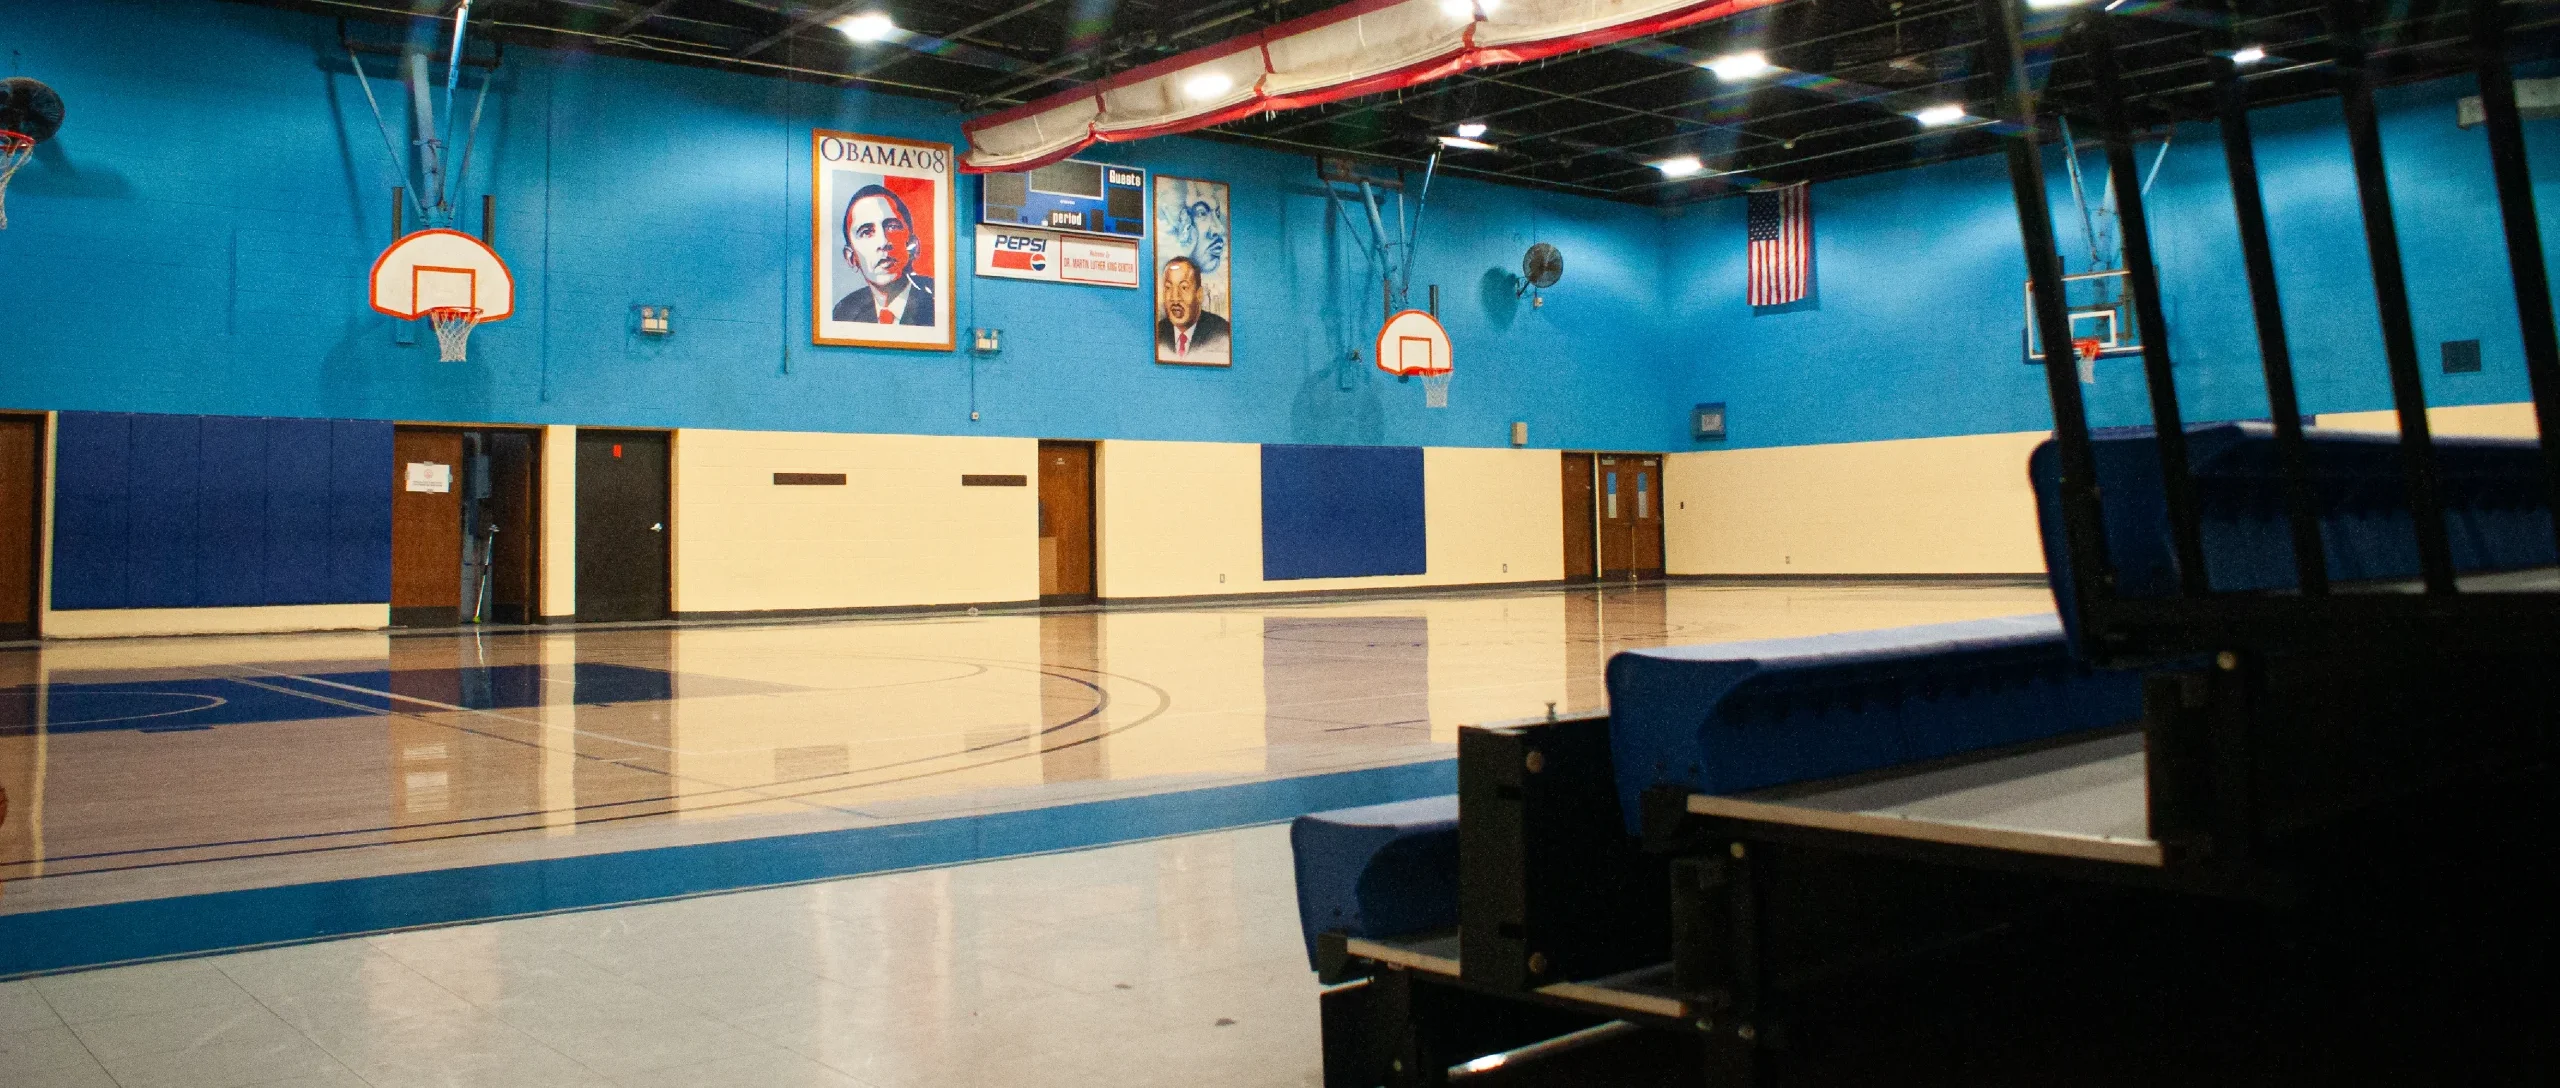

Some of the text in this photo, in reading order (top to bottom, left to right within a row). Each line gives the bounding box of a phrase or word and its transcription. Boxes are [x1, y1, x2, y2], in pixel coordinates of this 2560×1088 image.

[1109, 169, 1141, 187] Guests
[1052, 212, 1082, 226] period
[995, 234, 1047, 252] PEPSI
[1072, 258, 1090, 269] MARTIN
[1090, 260, 1106, 271] LUTHER
[1107, 262, 1118, 272] KING
